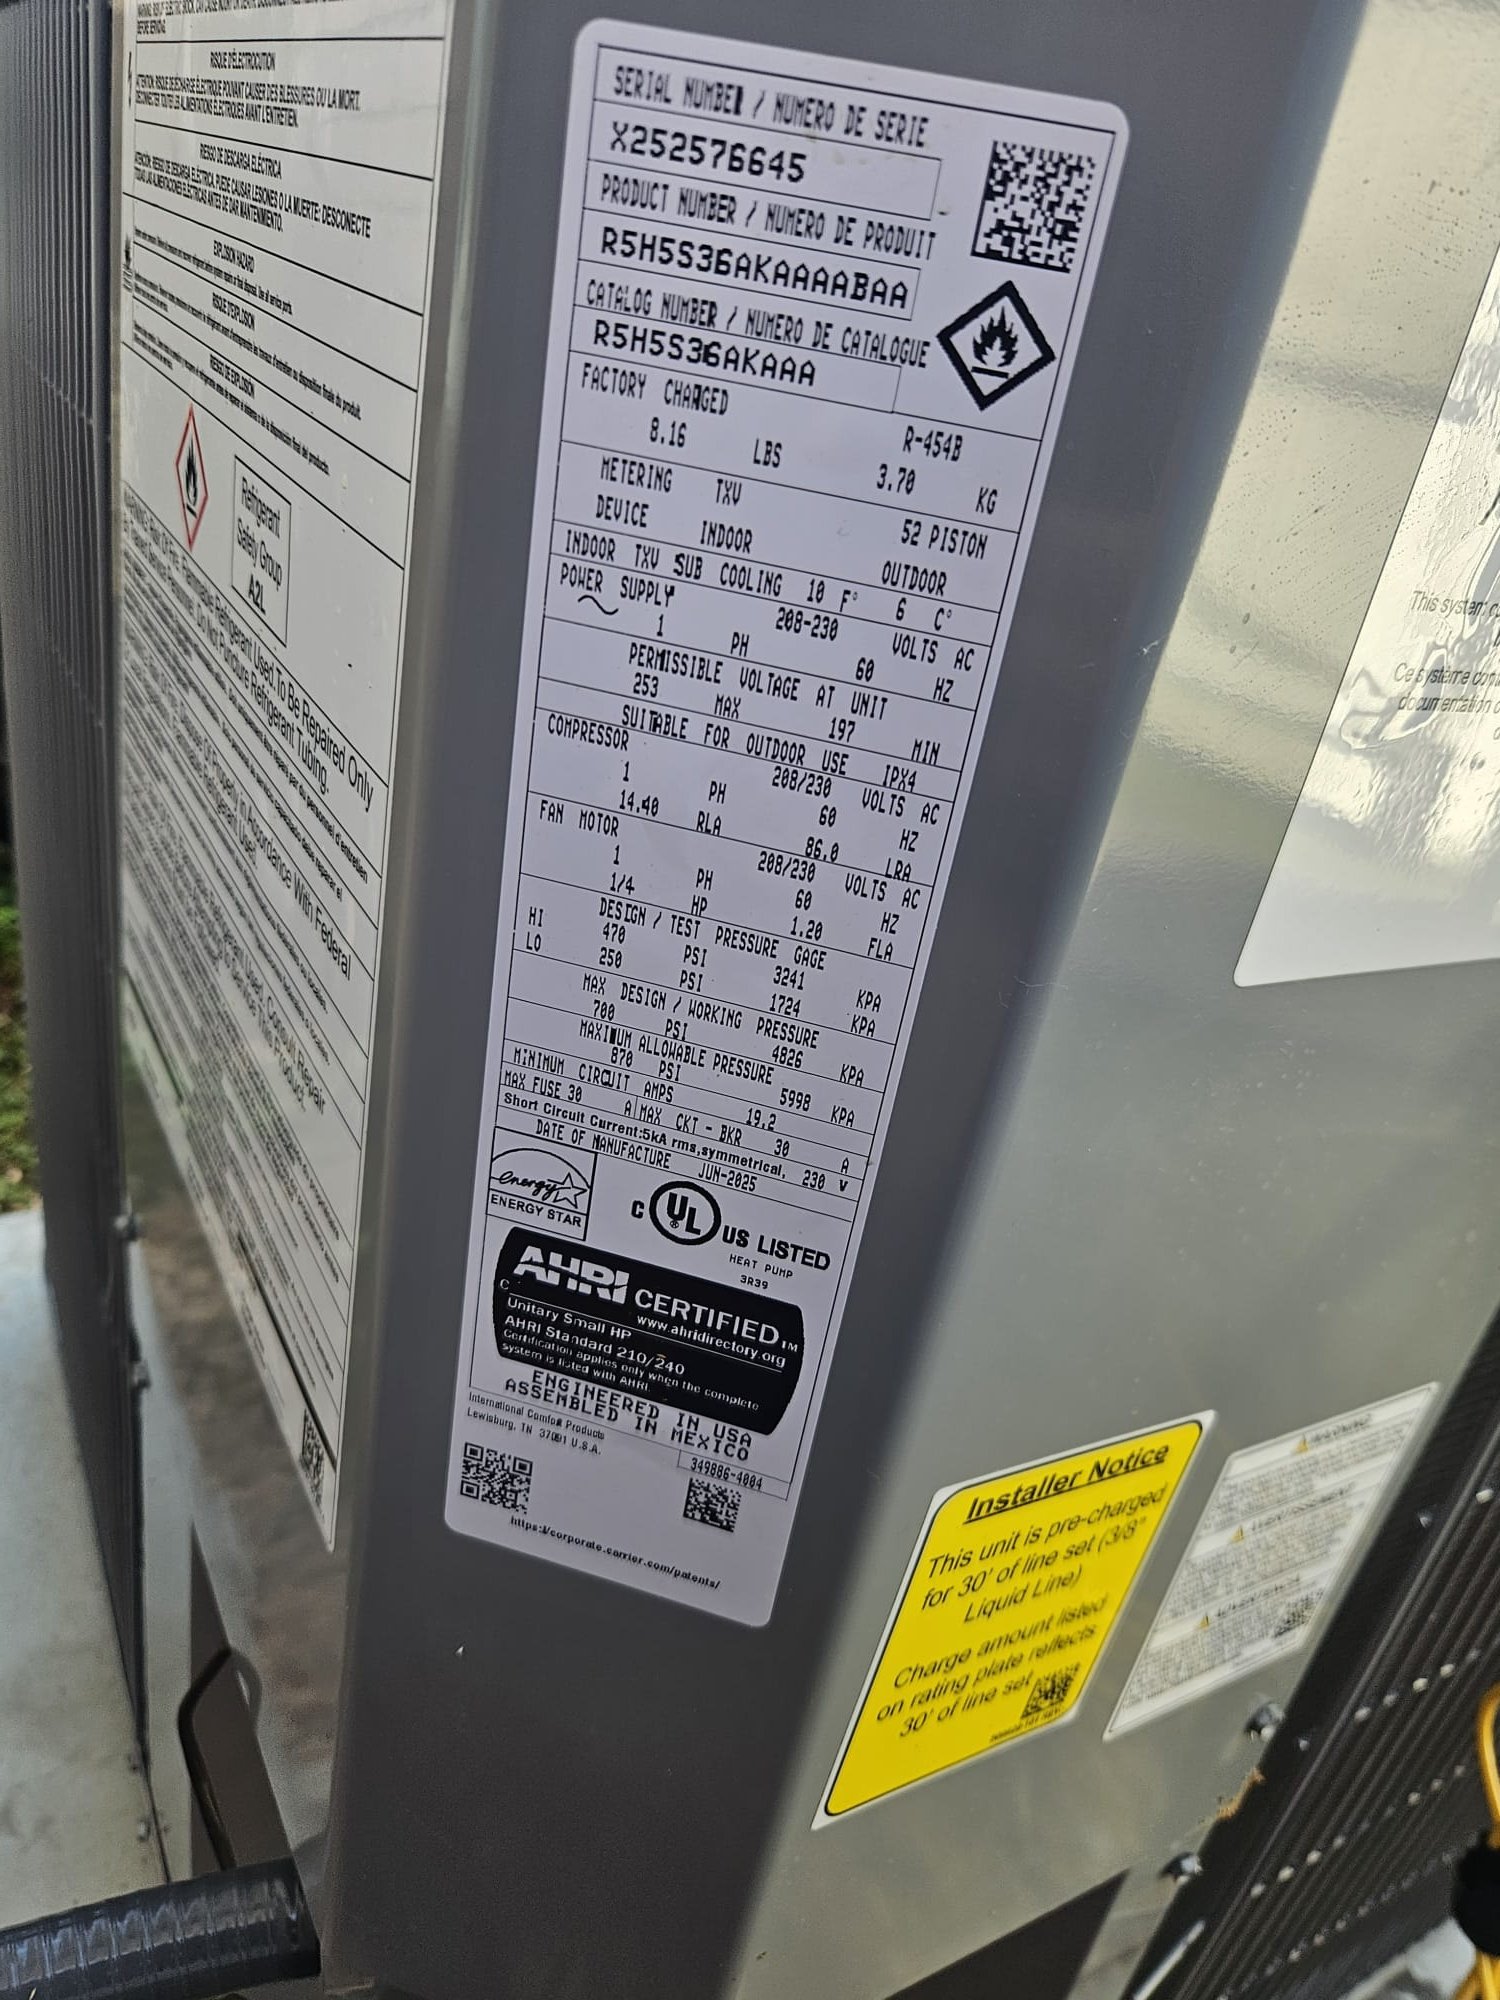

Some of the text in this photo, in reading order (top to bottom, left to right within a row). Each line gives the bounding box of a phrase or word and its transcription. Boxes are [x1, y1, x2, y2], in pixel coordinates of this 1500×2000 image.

[614, 65, 928, 147] SERIAL NUMERO SERIE
[611, 121, 806, 182] X252576645
[322, 204, 371, 238] DESCONECTE
[601, 173, 936, 260] PRODUCT NUMBER NUMERO PRODUIT
[601, 226, 908, 308] R5H5S36AKAAAABAA
[587, 279, 930, 368] CATALOG NUMBER CATALOGUE
[594, 319, 815, 386] R5H5S36AKAAA
[582, 362, 646, 398] FACTORY
[650, 417, 915, 495] 8.16 LBS 3.70
[902, 425, 962, 461] R-454B
[242, 476, 280, 539] Refrigerant
[600, 457, 988, 559] METERING TXV 52 PISTON
[237, 518, 258, 568] Safety
[260, 540, 282, 592] Group
[560, 562, 603, 592] POWER
[673, 553, 782, 597] SUB COOLING
[700, 520, 946, 596] INDOOR OUTDOOR
[248, 573, 266, 616] A2L
[775, 607, 938, 664] 208-230 VOLTS
[628, 642, 888, 720] PERMISSIBLE VOLTAGE UNIT
[633, 672, 855, 742] 253 MAX 197
[297, 727, 329, 795] Tubing.
[302, 699, 374, 813] Repaired Only
[548, 713, 832, 798] COMPRESSOR 208/230
[621, 704, 916, 793] SUITABLE IPX4
[539, 799, 618, 837] FAN MOTOR
[315, 908, 351, 982] Federal
[599, 897, 826, 970] DESIGN TEST PRESSURE GAGE
[790, 917, 822, 941] 1.20
[599, 946, 800, 1020] 250 1724
[602, 922, 881, 1012] 470 PSI 3241 KPA
[582, 973, 819, 1049] MAX WORKING PRESSURE
[593, 999, 803, 1071] 700 4826
[610, 1046, 811, 1112] 870 5998
[638, 1034, 706, 1067] ALLOWABLE
[504, 1092, 538, 1111] Short
[543, 1102, 584, 1123] Circuit
[531, 1076, 562, 1099] FUSE
[578, 1063, 630, 1094] CIRCUIT
[642, 1080, 673, 1105] AMPS
[744, 1107, 776, 1133] 19.2
[535, 1118, 757, 1192] DATE MANUFACTURE JUN-2025
[801, 1169, 825, 1192] 230
[490, 1193, 581, 1227] ENERGY STAR
[513, 1245, 629, 1304] AHRI
[722, 1225, 830, 1270] US LISTED
[729, 1253, 793, 1278] HEAT PUMP
[740, 1274, 768, 1289] 3R39
[504, 1315, 684, 1374] AHRI Standard 210/240
[507, 1297, 605, 1333] Unitary Small
[634, 1289, 779, 1344] CERTIFIED
[637, 1315, 785, 1368] www.ahridirectory.org
[467, 1406, 516, 1430] Lewisburg,
[469, 1391, 524, 1415] International
[505, 1378, 748, 1461] ASSEMBLED MEXICO
[532, 1369, 751, 1448] ENGINEERED IN USA
[704, 1389, 758, 1410] complete
[966, 1445, 1169, 1519] Installer Notice
[921, 1586, 953, 1610] for
[996, 1558, 1021, 1583] of
[1021, 1550, 1058, 1574] line
[1062, 1535, 1095, 1560] set
[928, 1548, 973, 1578] This
[978, 1531, 1020, 1561] unit
[1023, 1526, 1042, 1546] is
[963, 1583, 1028, 1623] Liquid
[893, 1648, 971, 1688] Charge
[976, 1615, 1053, 1657] amount
[876, 1699, 904, 1721] on
[910, 1674, 969, 1708] rating
[936, 1700, 959, 1721] of
[961, 1687, 997, 1711] line
